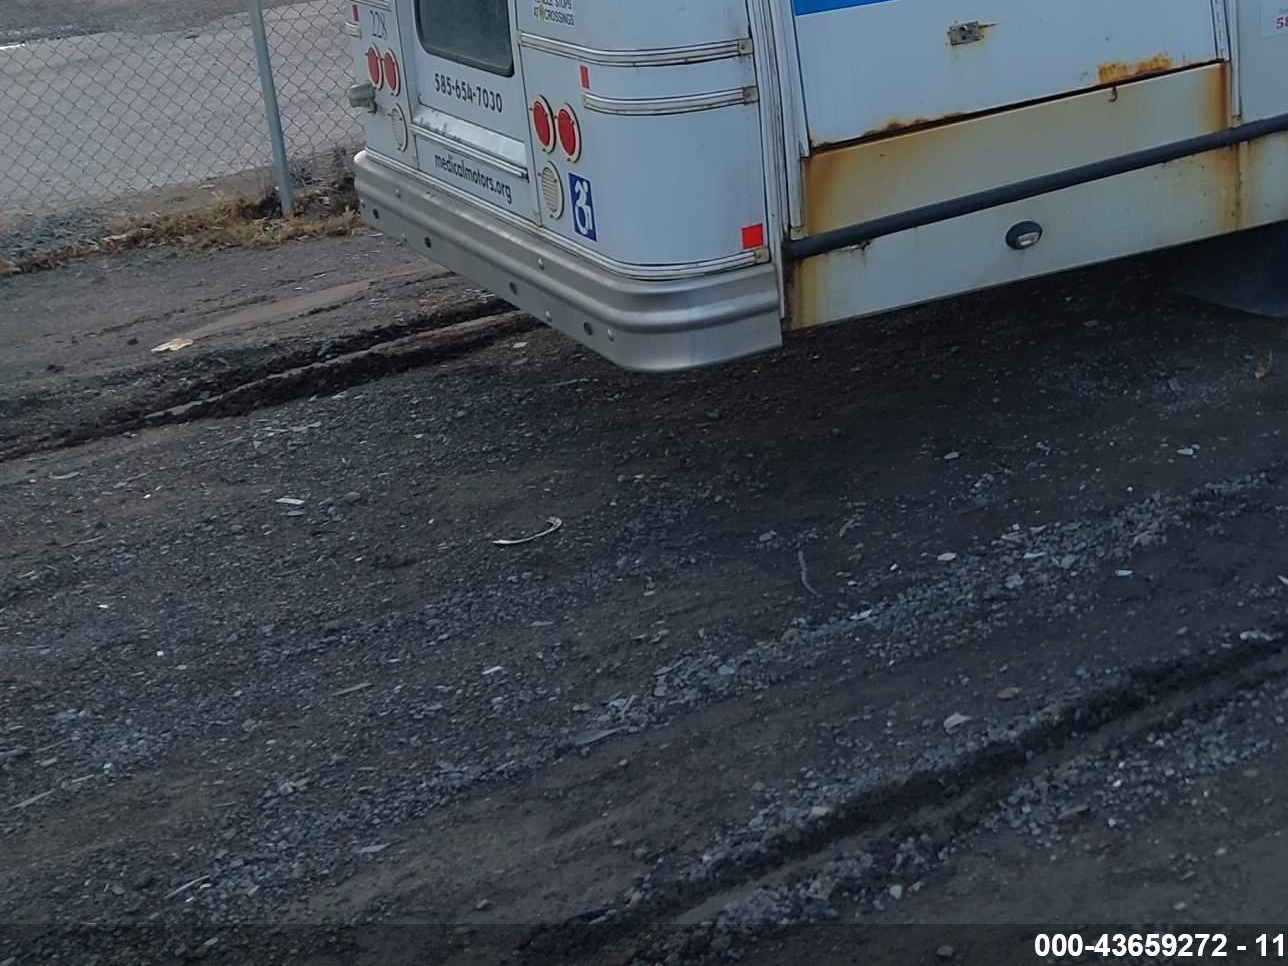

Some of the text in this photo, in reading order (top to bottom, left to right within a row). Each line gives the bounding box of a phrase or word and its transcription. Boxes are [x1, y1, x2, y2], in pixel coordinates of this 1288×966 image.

[369, 9, 388, 41] 228
[434, 72, 503, 114] 585-654-7030
[434, 153, 513, 205] medicalmotors.org
